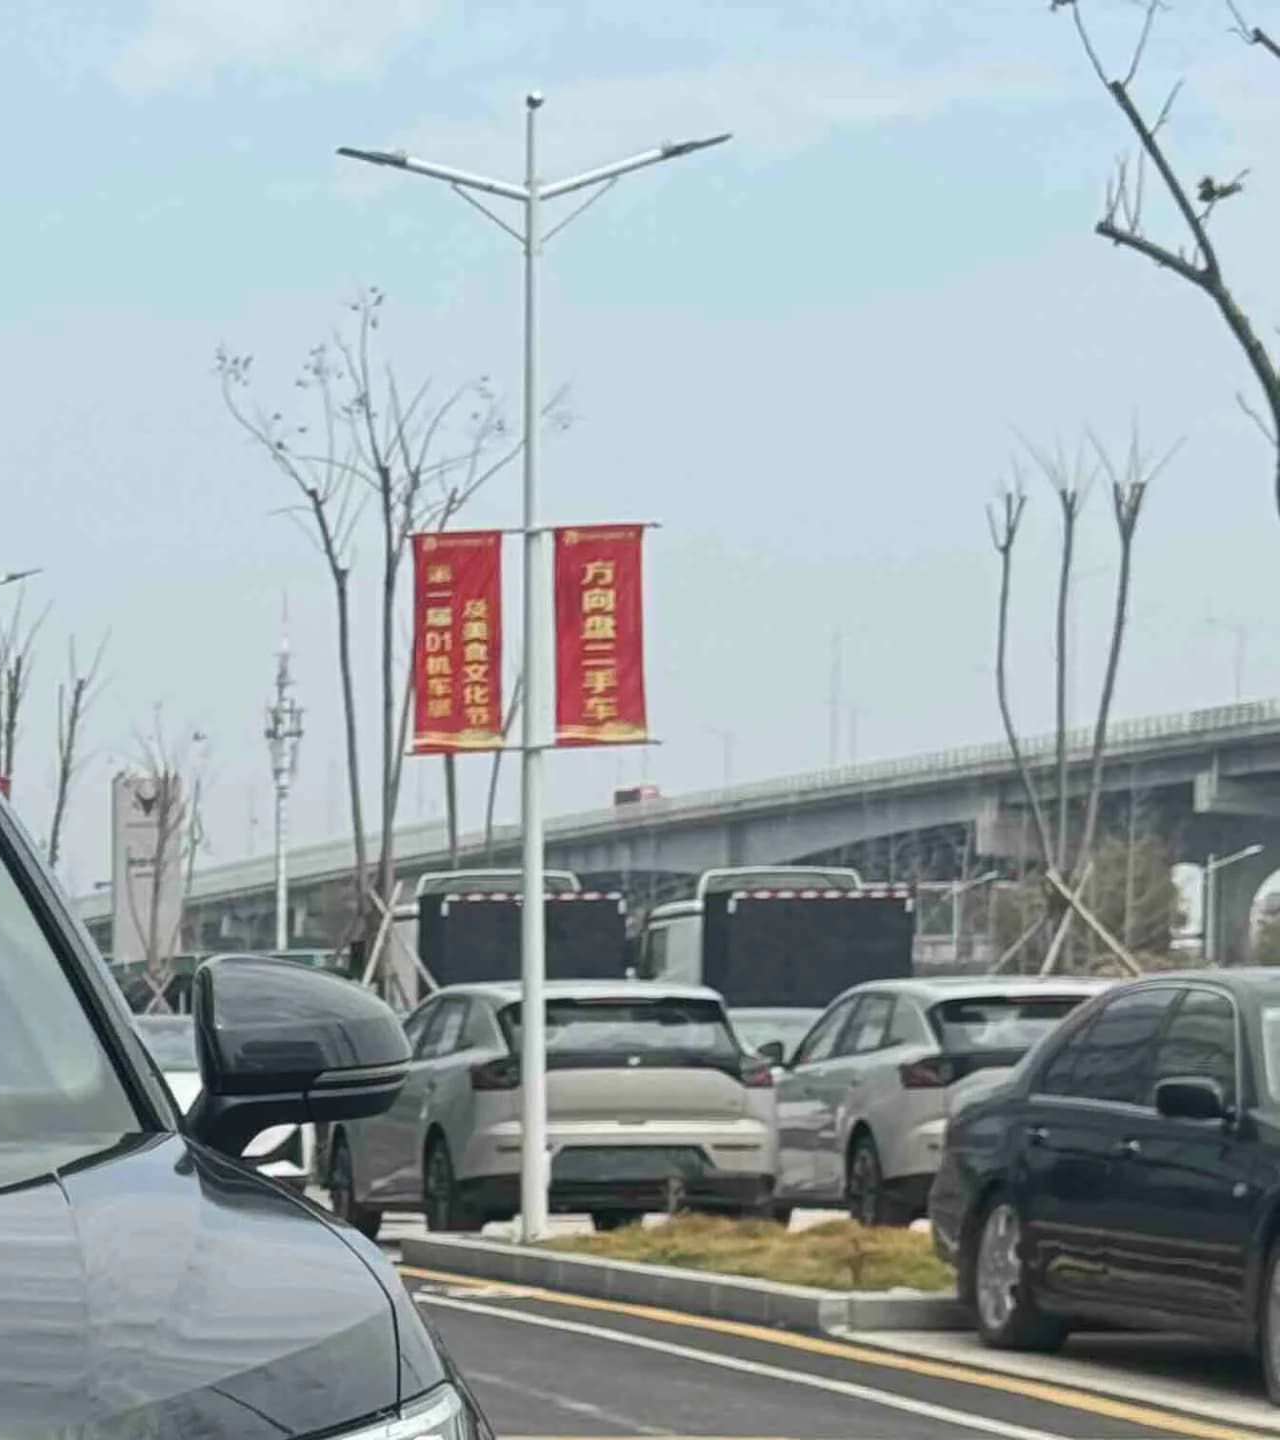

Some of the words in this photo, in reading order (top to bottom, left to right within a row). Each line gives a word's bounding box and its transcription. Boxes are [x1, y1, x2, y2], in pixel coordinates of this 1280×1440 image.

[581, 561, 618, 721] 方向盘二手车
